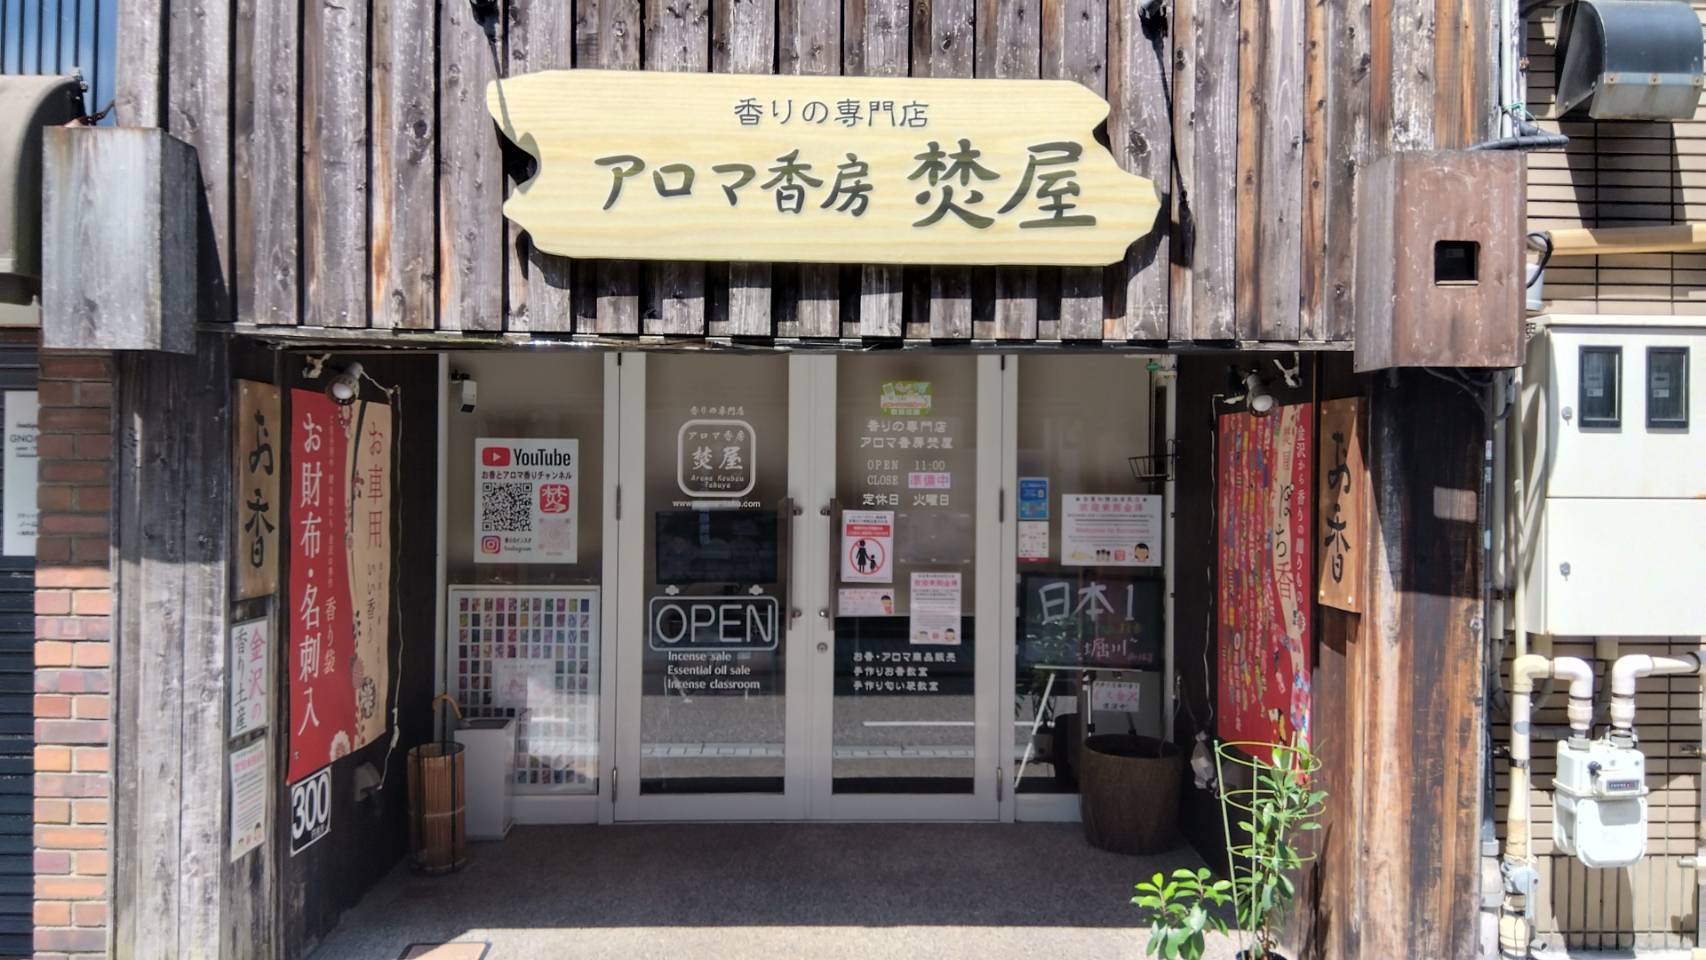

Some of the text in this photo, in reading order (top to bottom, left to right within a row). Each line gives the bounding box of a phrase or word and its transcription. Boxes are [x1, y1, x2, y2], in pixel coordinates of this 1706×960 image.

[734, 98, 930, 129] 香りの専門店
[594, 138, 1098, 230] アロマ香房 焚屋
[690, 405, 745, 416] 香りの専門店
[867, 420, 948, 432] 香りの専門店
[687, 430, 745, 442] アロマ香房
[513, 448, 571, 467] YouTube
[692, 446, 743, 470] 焚屋
[867, 460, 945, 471] OPEN 11:00
[481, 470, 572, 480] お香とアロマ香りチャンネル
[867, 475, 899, 486] CLOSE
[245, 409, 275, 568] お香
[367, 420, 384, 549] お車用
[863, 493, 950, 507] 定休日 火曜日
[1324, 431, 1351, 583] お香
[298, 412, 323, 737] お財布・名刺入
[655, 604, 773, 643] OPEN
[323, 596, 337, 674] 香り袋
[668, 650, 732, 661] Incense sale
[853, 651, 957, 662] お香・アロマ商品販売
[248, 626, 266, 721] 金沢の
[667, 665, 751, 676] Essential oil sale
[853, 666, 929, 677] 手作りお香教室
[667, 678, 761, 689] Incense classroom
[292, 773, 330, 840] 300
